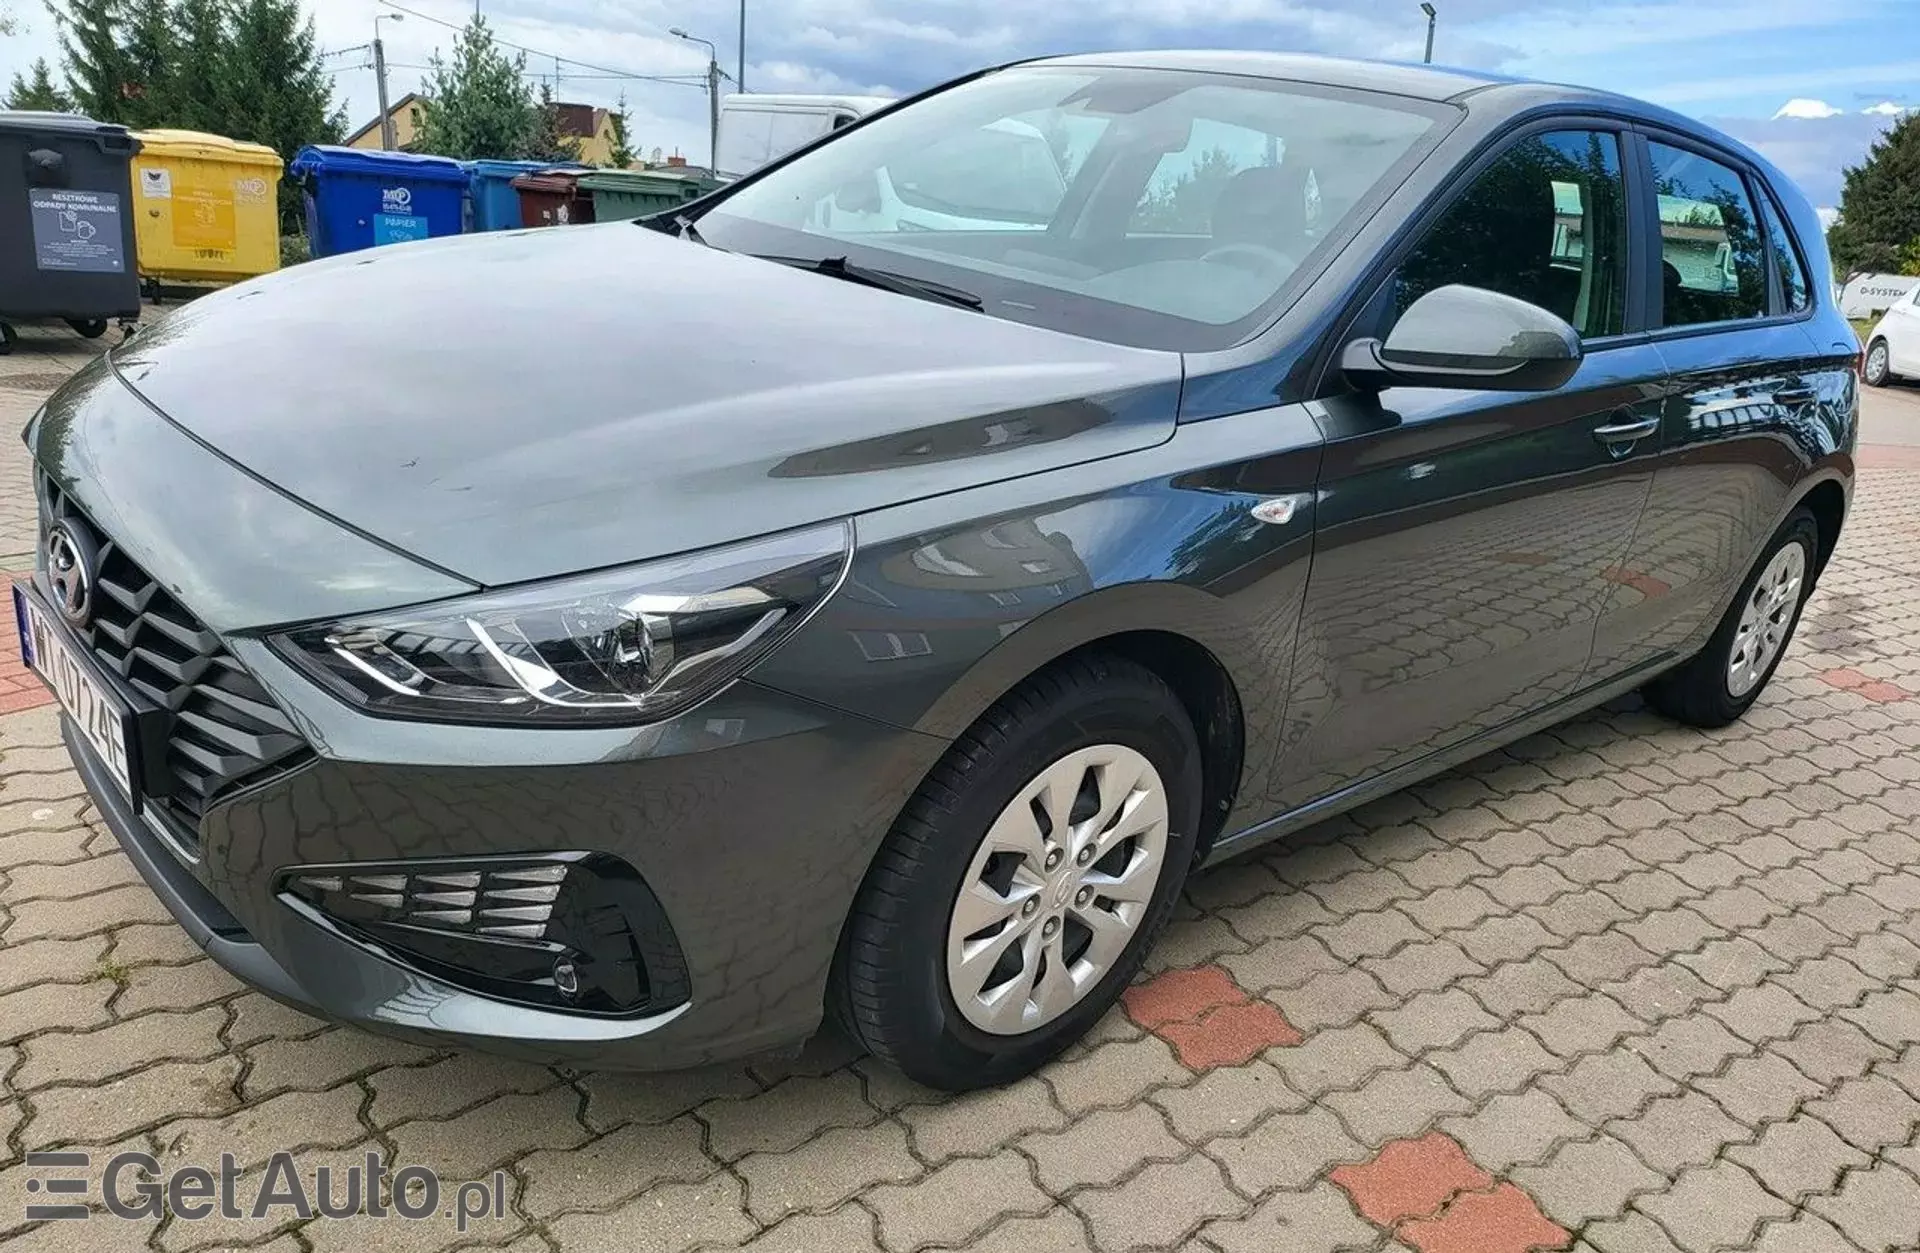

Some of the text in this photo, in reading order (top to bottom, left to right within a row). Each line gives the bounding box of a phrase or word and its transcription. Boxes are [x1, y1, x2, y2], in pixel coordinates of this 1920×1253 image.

[52, 193, 98, 203] RESZTKOWE
[33, 201, 117, 213] ODPADY KOMUNALNE
[385, 217, 417, 228] PAPIER
[60, 646, 128, 783] 0724E
